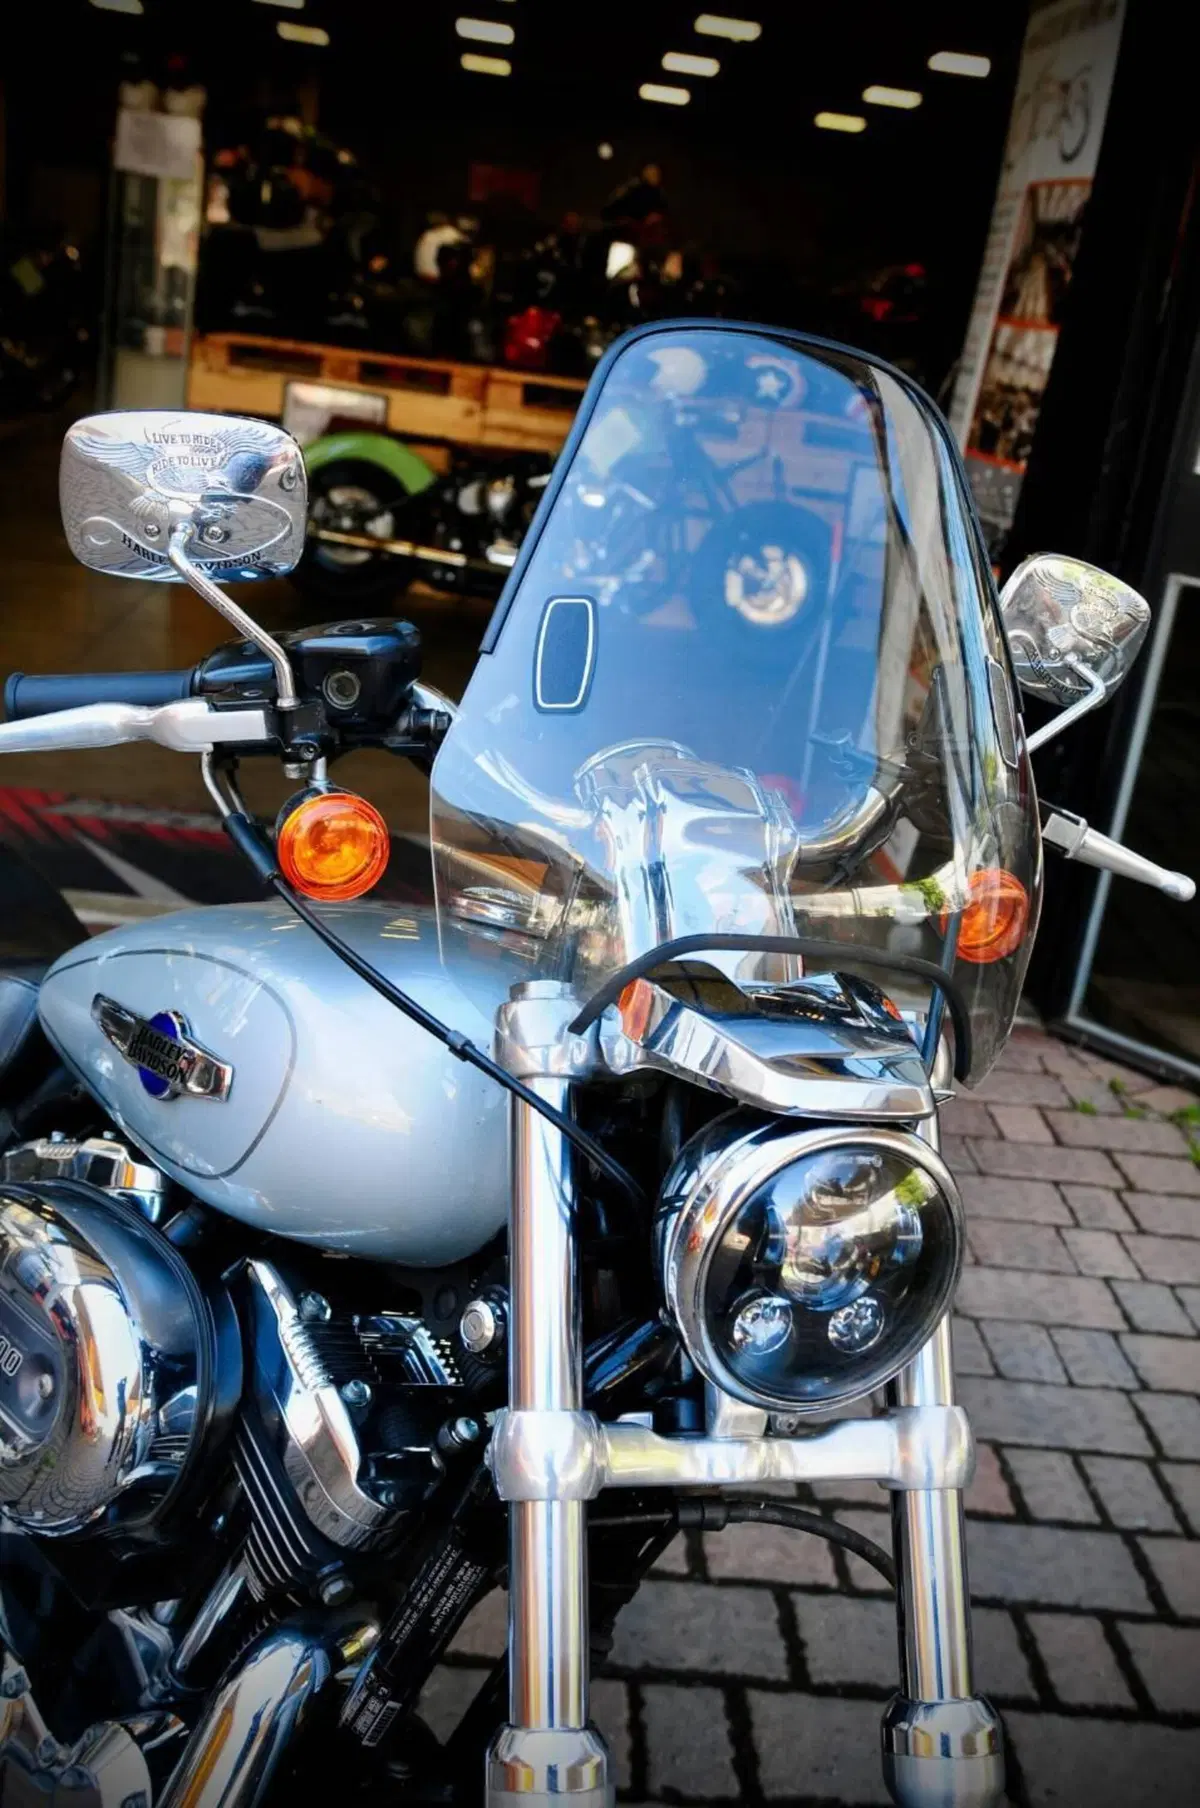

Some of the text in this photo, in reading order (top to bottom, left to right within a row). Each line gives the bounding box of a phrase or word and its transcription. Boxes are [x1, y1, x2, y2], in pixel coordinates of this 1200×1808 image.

[152, 432, 217, 448] LIVE TO RIDE
[152, 455, 217, 475] RIDE TO LIVE
[128, 1036, 188, 1084] DAVIDSON
